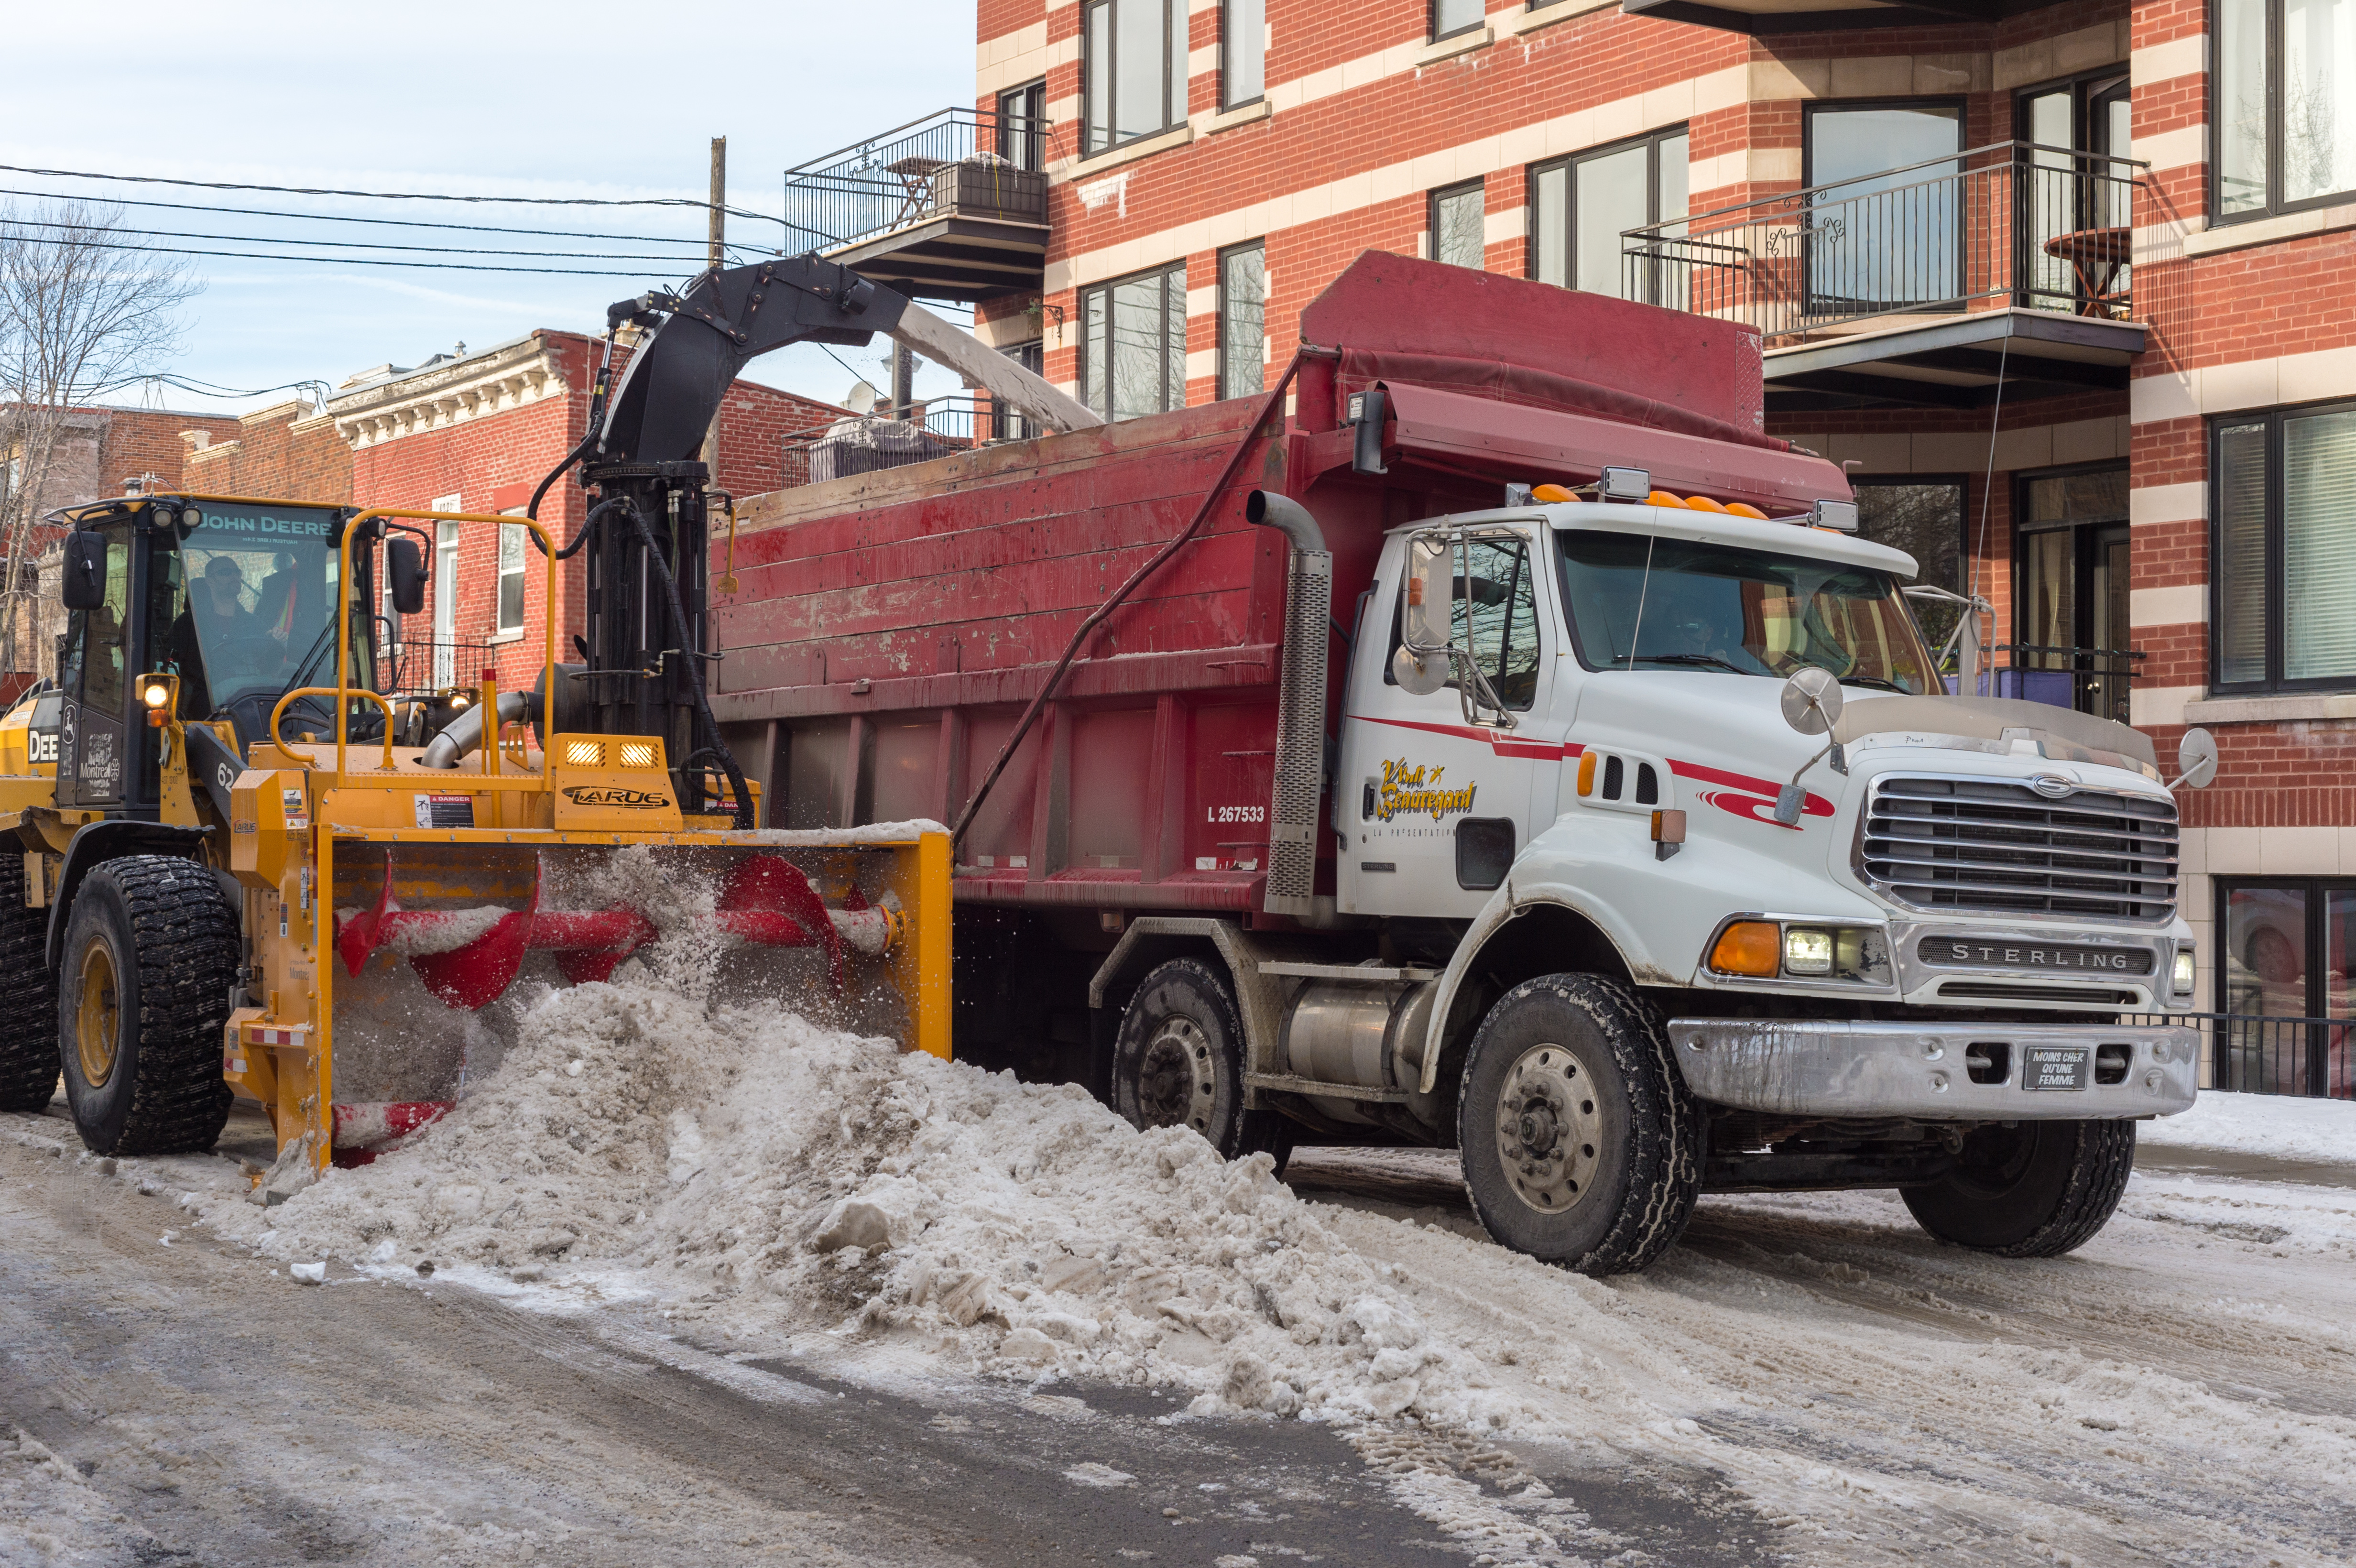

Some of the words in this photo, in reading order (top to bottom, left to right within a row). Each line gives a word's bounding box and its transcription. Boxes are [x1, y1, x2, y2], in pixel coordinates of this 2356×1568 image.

[197, 512, 255, 531] JOHN
[261, 516, 333, 536] DEERE
[572, 790, 669, 807] LARUE
[1377, 781, 1476, 819] Beauregard
[1208, 806, 1215, 822] L
[1218, 806, 1265, 822] 267533
[233, 823, 256, 833] LARUE
[1374, 828, 1382, 837] LA
[1952, 944, 2127, 969] STERLING
[2033, 1052, 2062, 1062] MOINS
[2062, 1052, 2084, 1063] CHER
[2042, 1063, 2074, 1074] QU'UNE
[2038, 1075, 2075, 1085] FEMME
